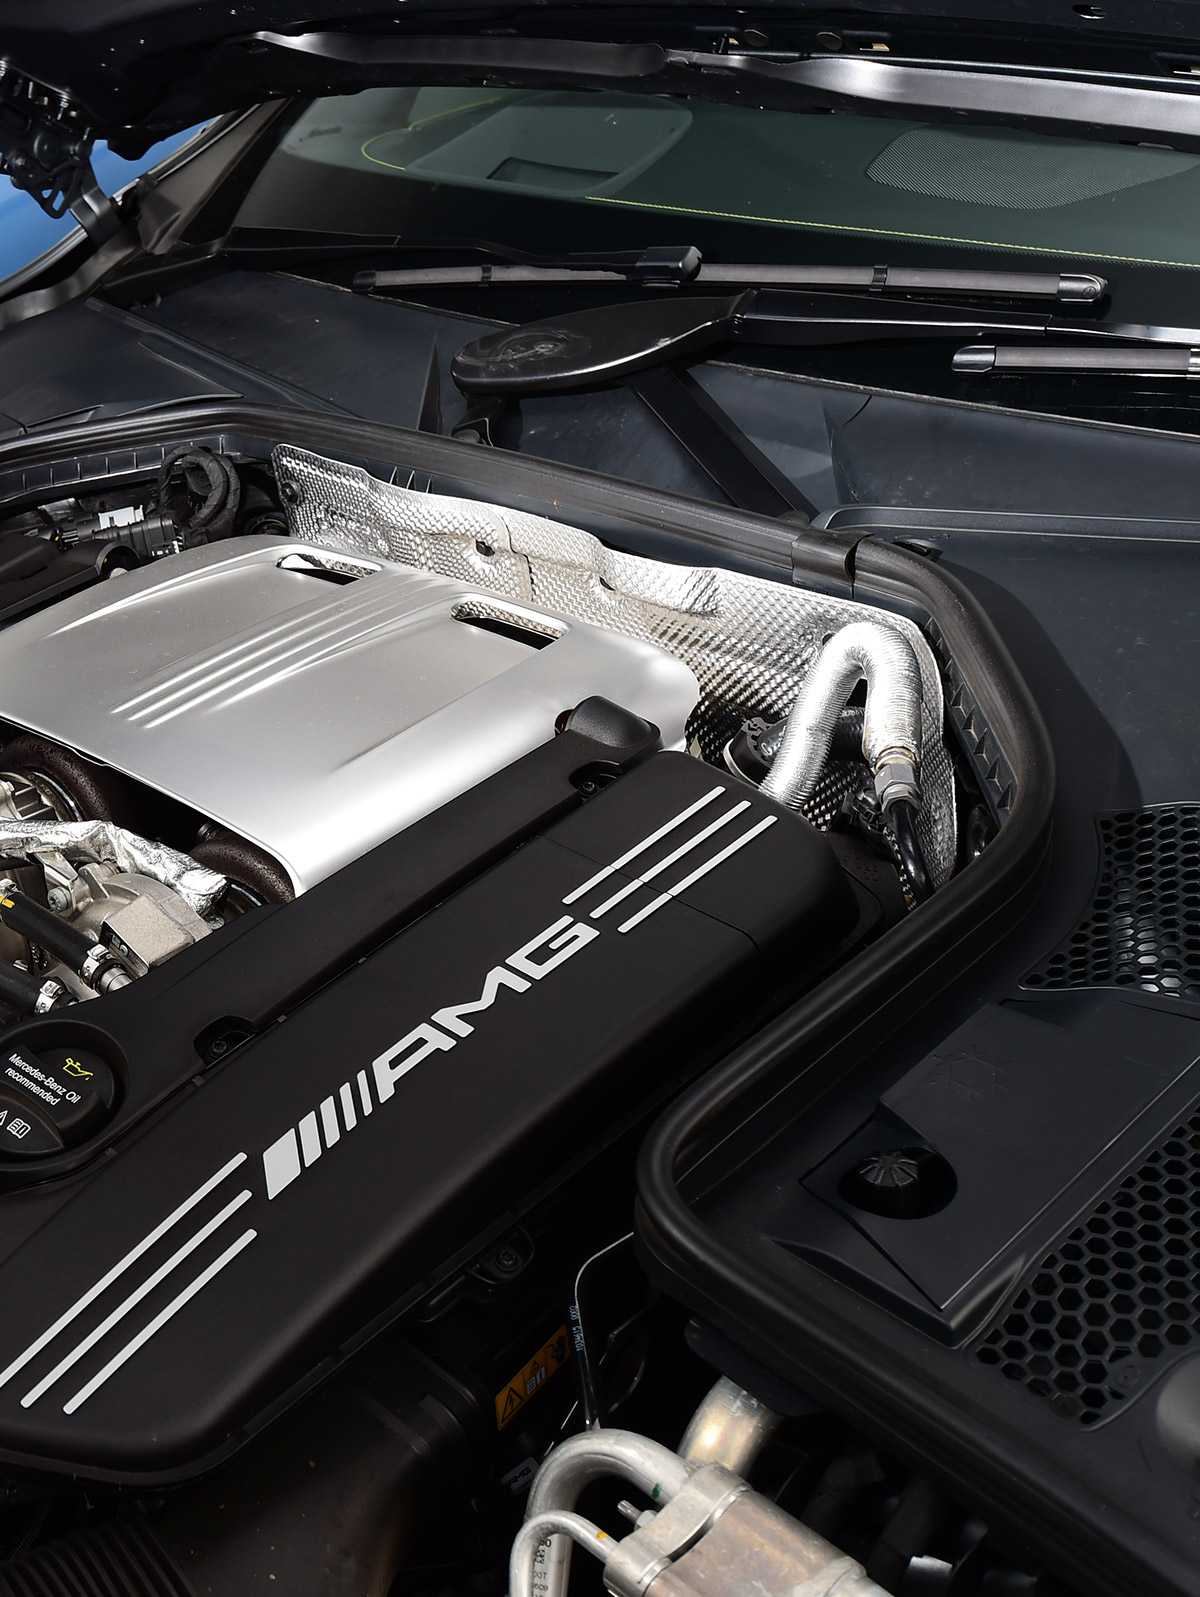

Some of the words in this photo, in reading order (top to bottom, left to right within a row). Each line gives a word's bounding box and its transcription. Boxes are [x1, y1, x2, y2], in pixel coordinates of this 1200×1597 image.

[372, 915, 600, 1103] AMG
[4, 1067, 61, 1106] recommended
[8, 1053, 67, 1096] Mercedes-Benz
[65, 1091, 82, 1104] Oil
